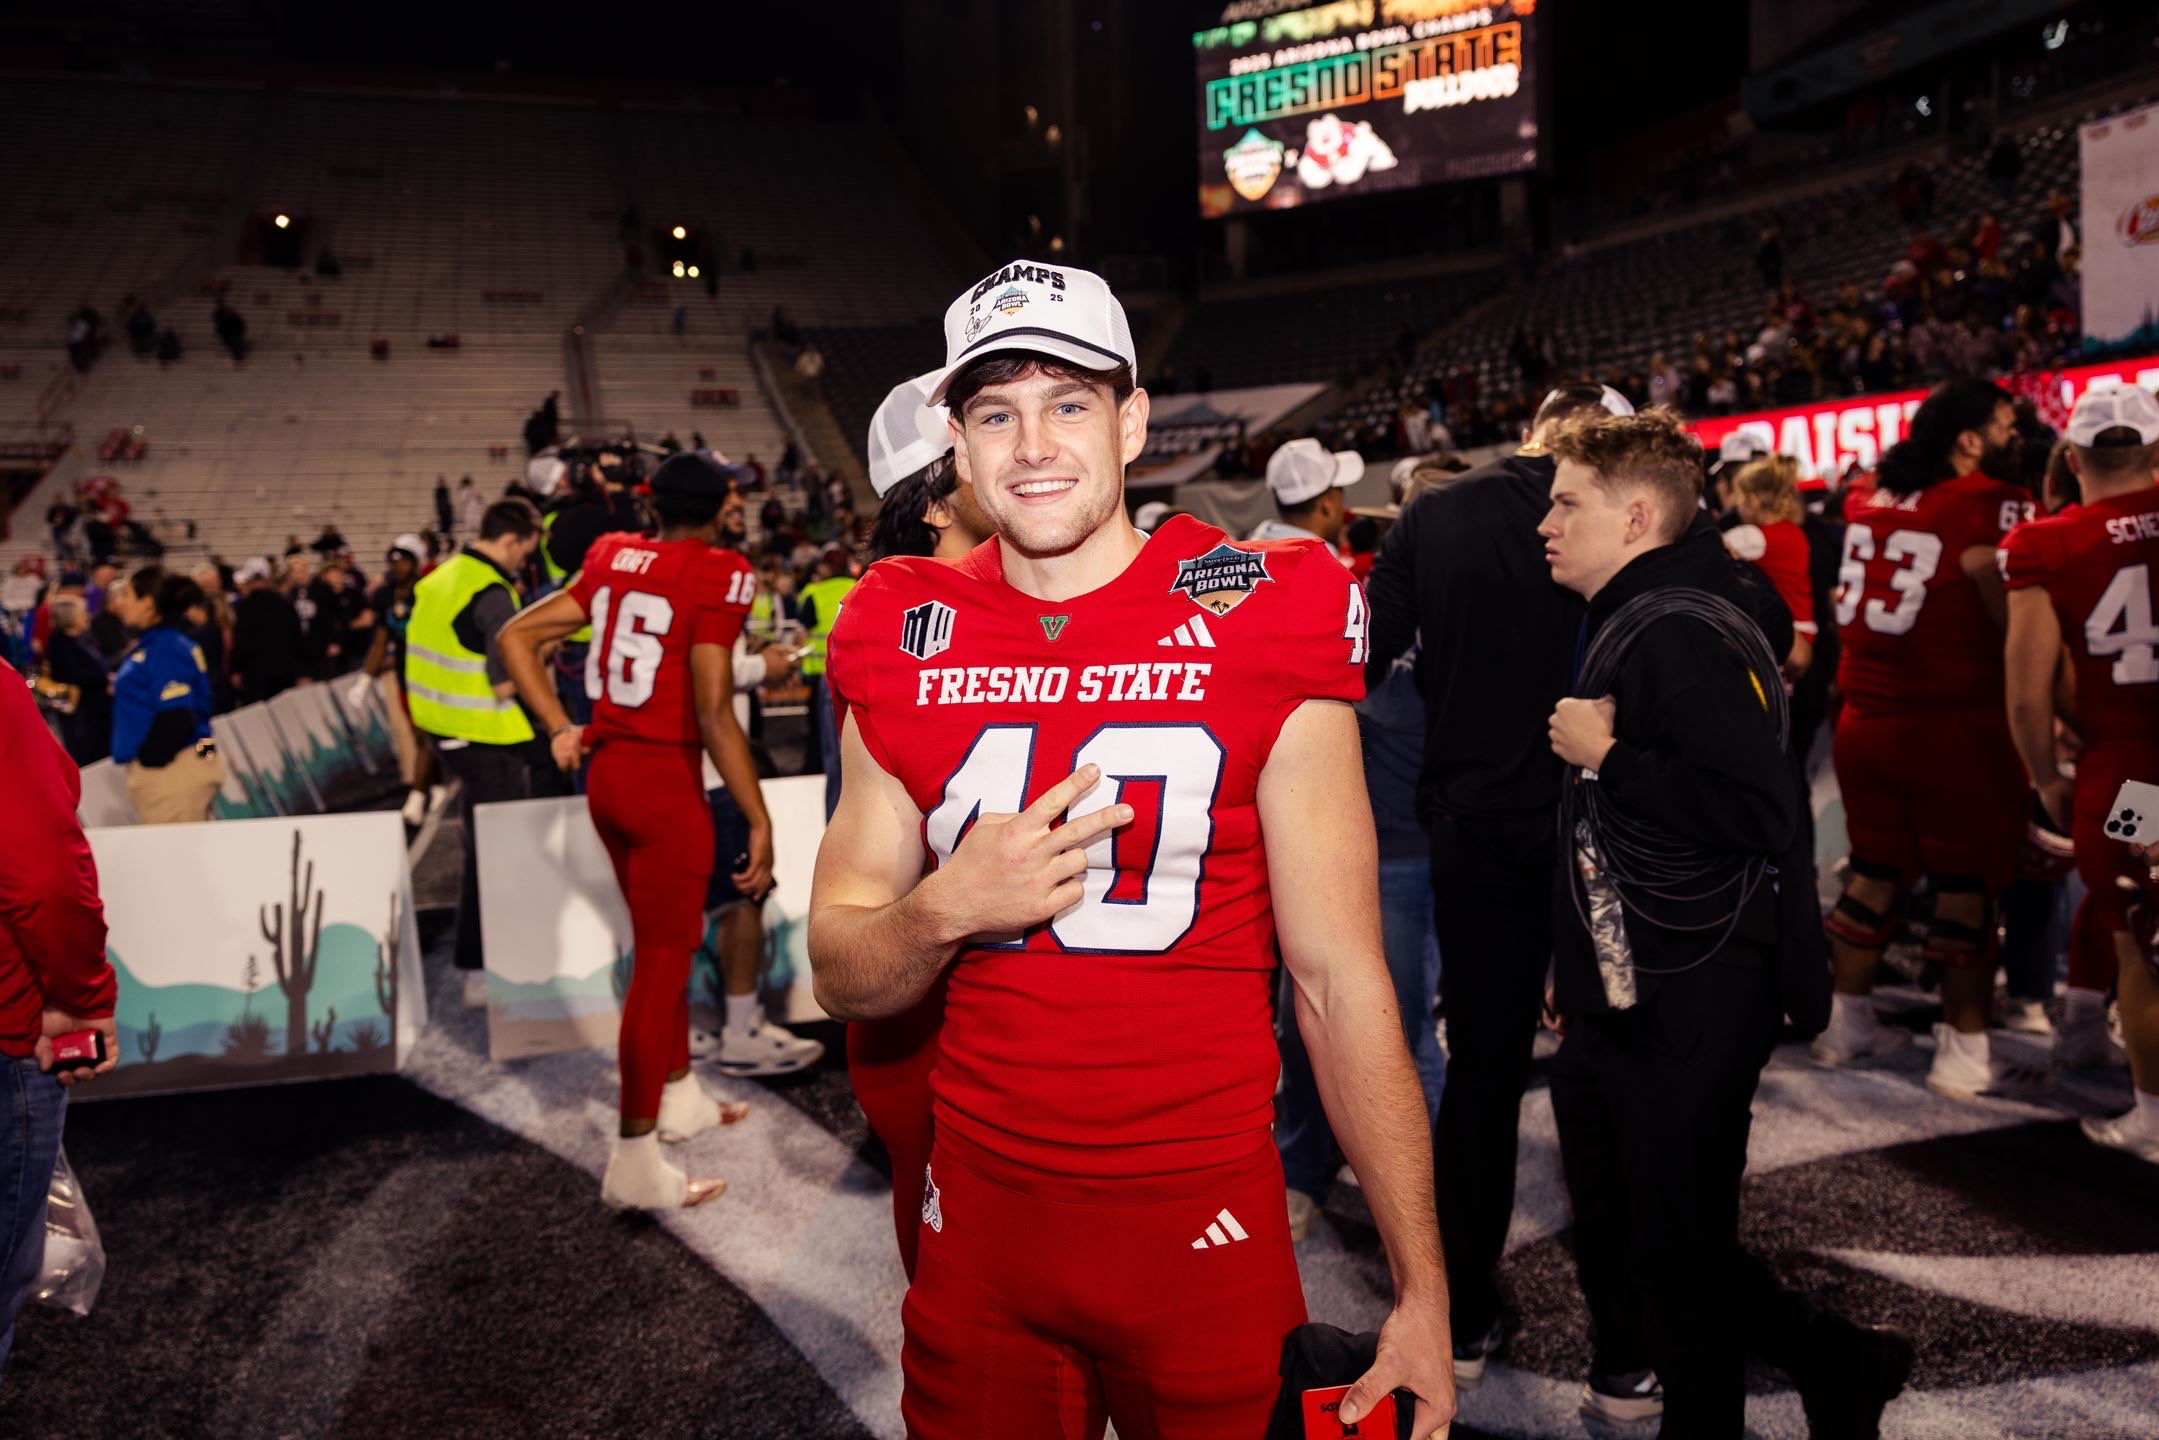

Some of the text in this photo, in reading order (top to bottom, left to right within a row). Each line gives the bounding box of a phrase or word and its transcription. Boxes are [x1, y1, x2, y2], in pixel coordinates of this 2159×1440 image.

[970, 264, 1066, 304] CHAMPS
[1050, 293, 1064, 302] 25
[725, 570, 756, 605] 16
[1181, 561, 1260, 583] ARIZONA
[1196, 574, 1248, 592] BOWL
[1836, 522, 1943, 635] 63
[1040, 615, 1068, 640] V
[584, 585, 674, 708] 16
[916, 662, 1213, 705] FRESNO STATE
[924, 721, 1228, 955] 40
